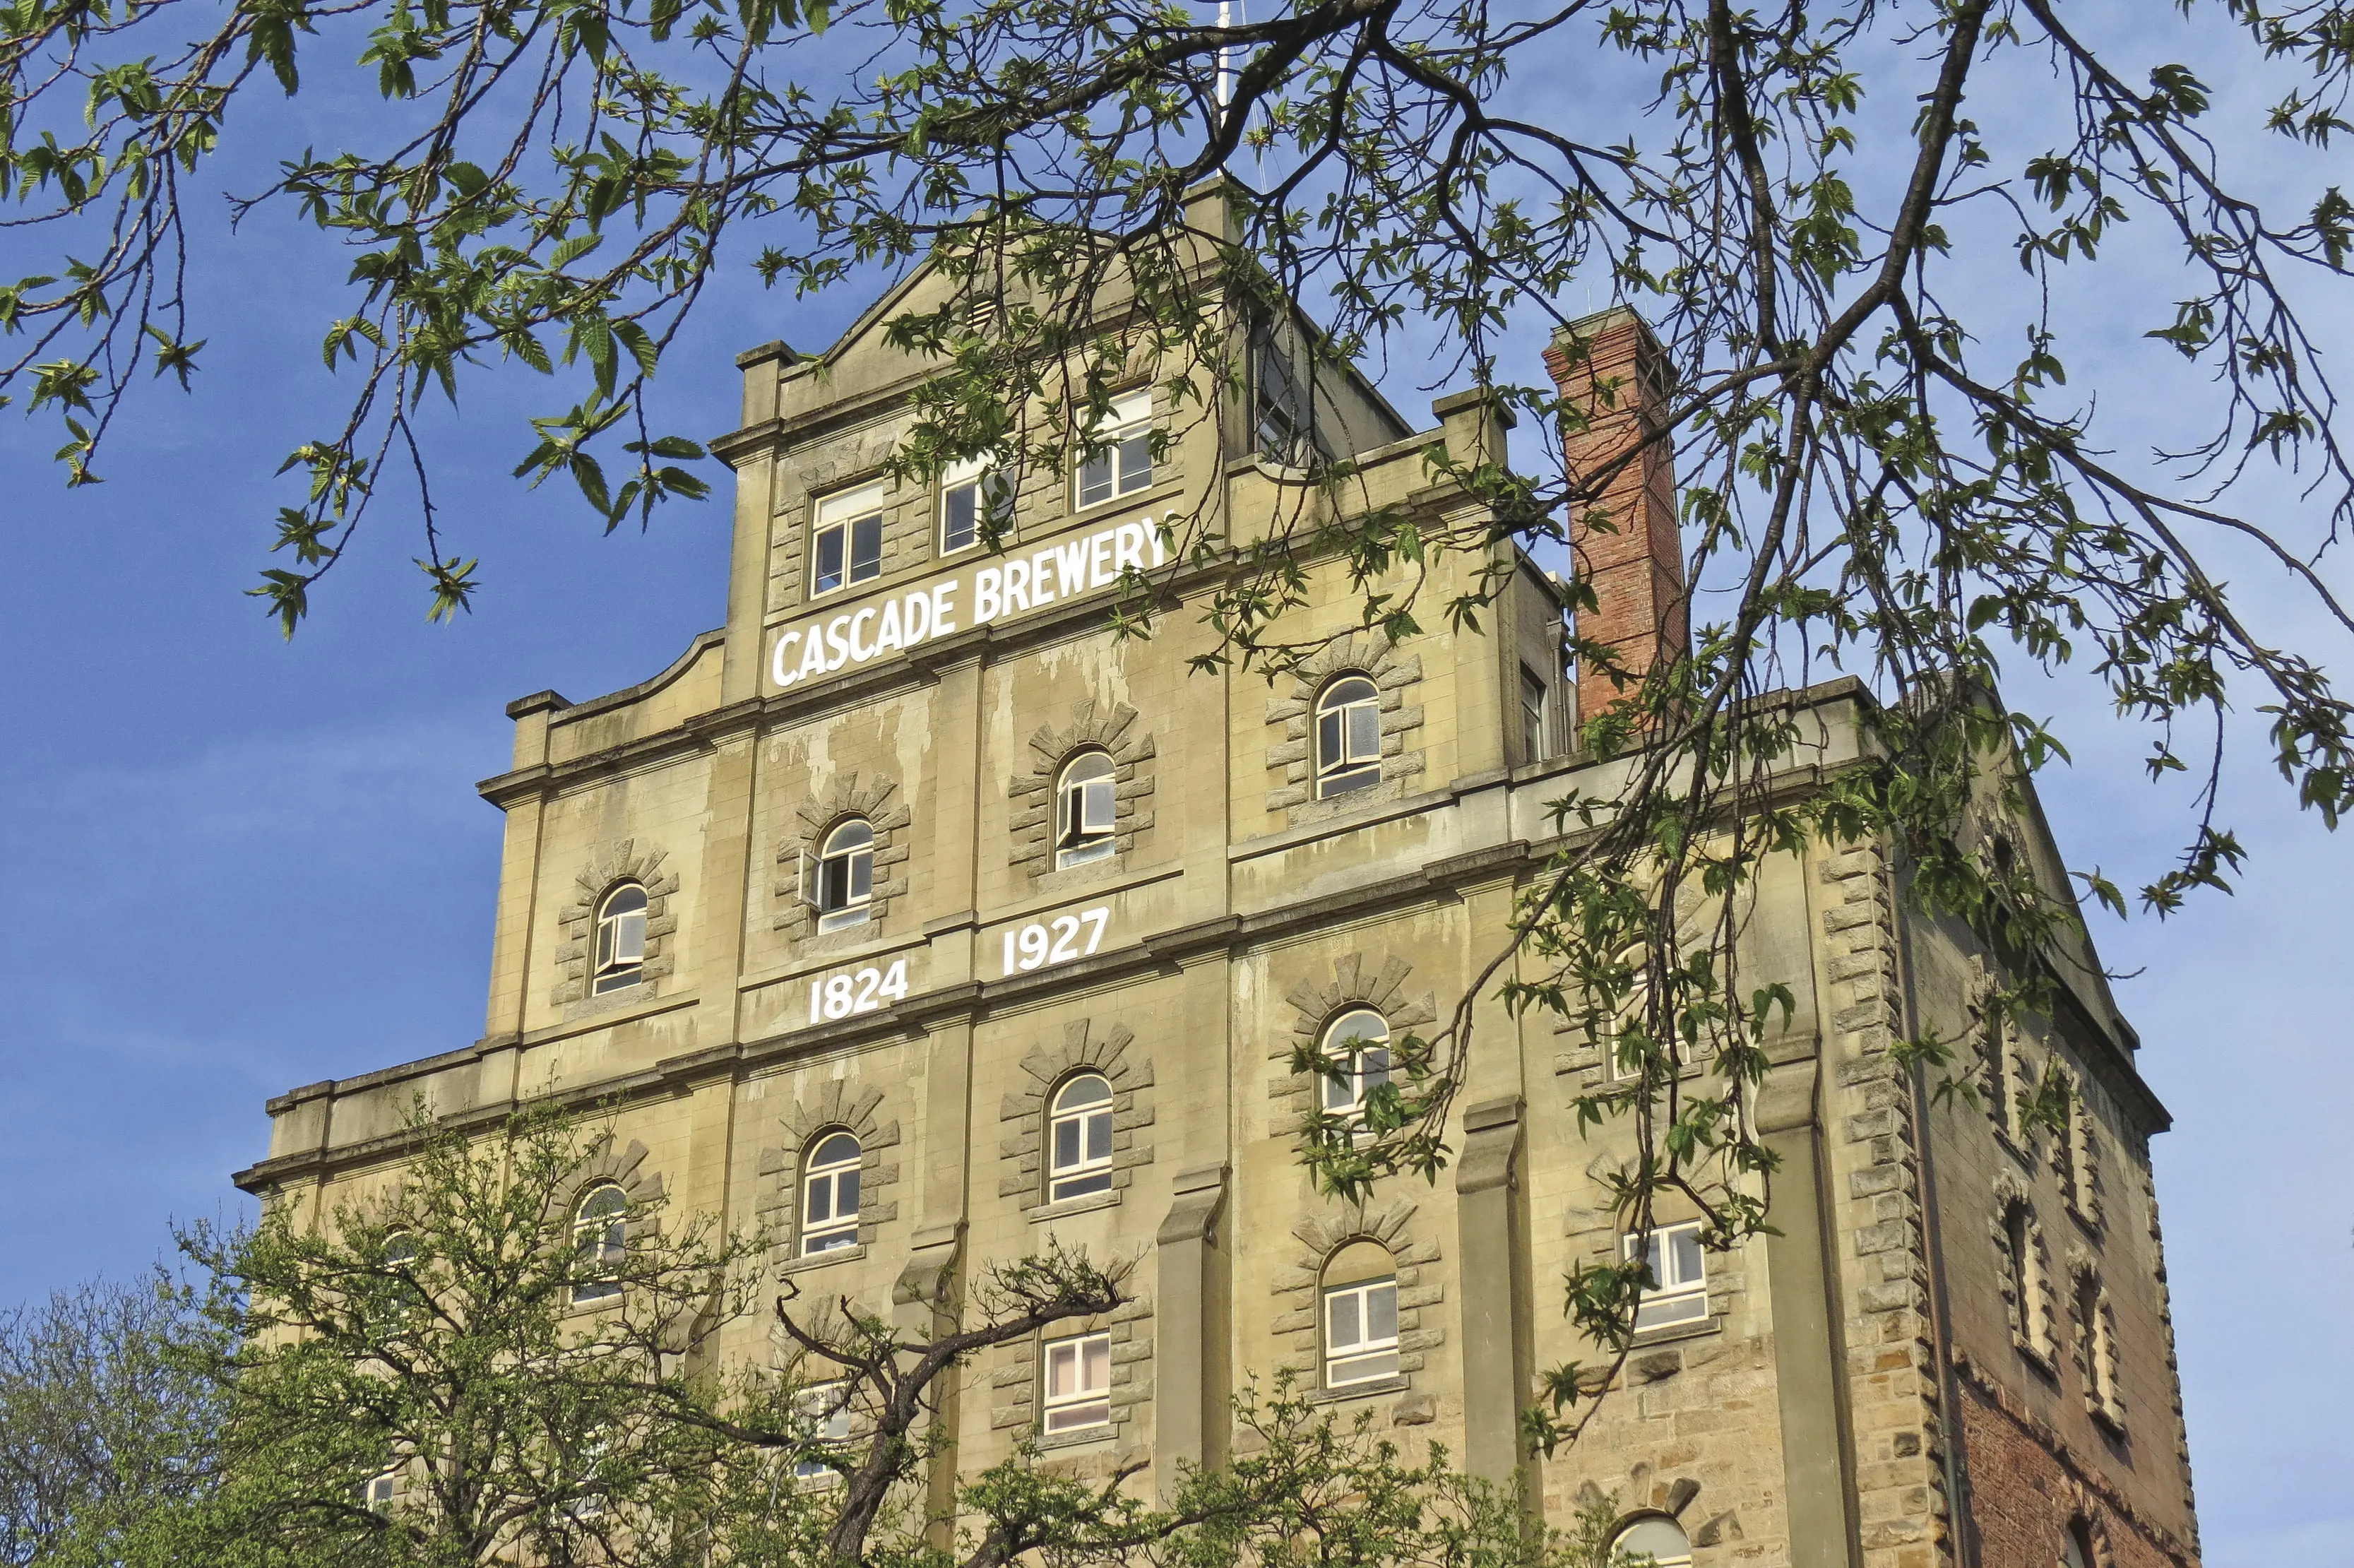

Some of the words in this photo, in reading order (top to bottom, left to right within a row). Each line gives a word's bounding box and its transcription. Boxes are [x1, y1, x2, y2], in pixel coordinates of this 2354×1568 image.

[772, 581, 959, 687] CASCADE
[974, 510, 1175, 624] BREWERY
[811, 959, 908, 1025] 1824
[1004, 906, 1110, 976] 1927
